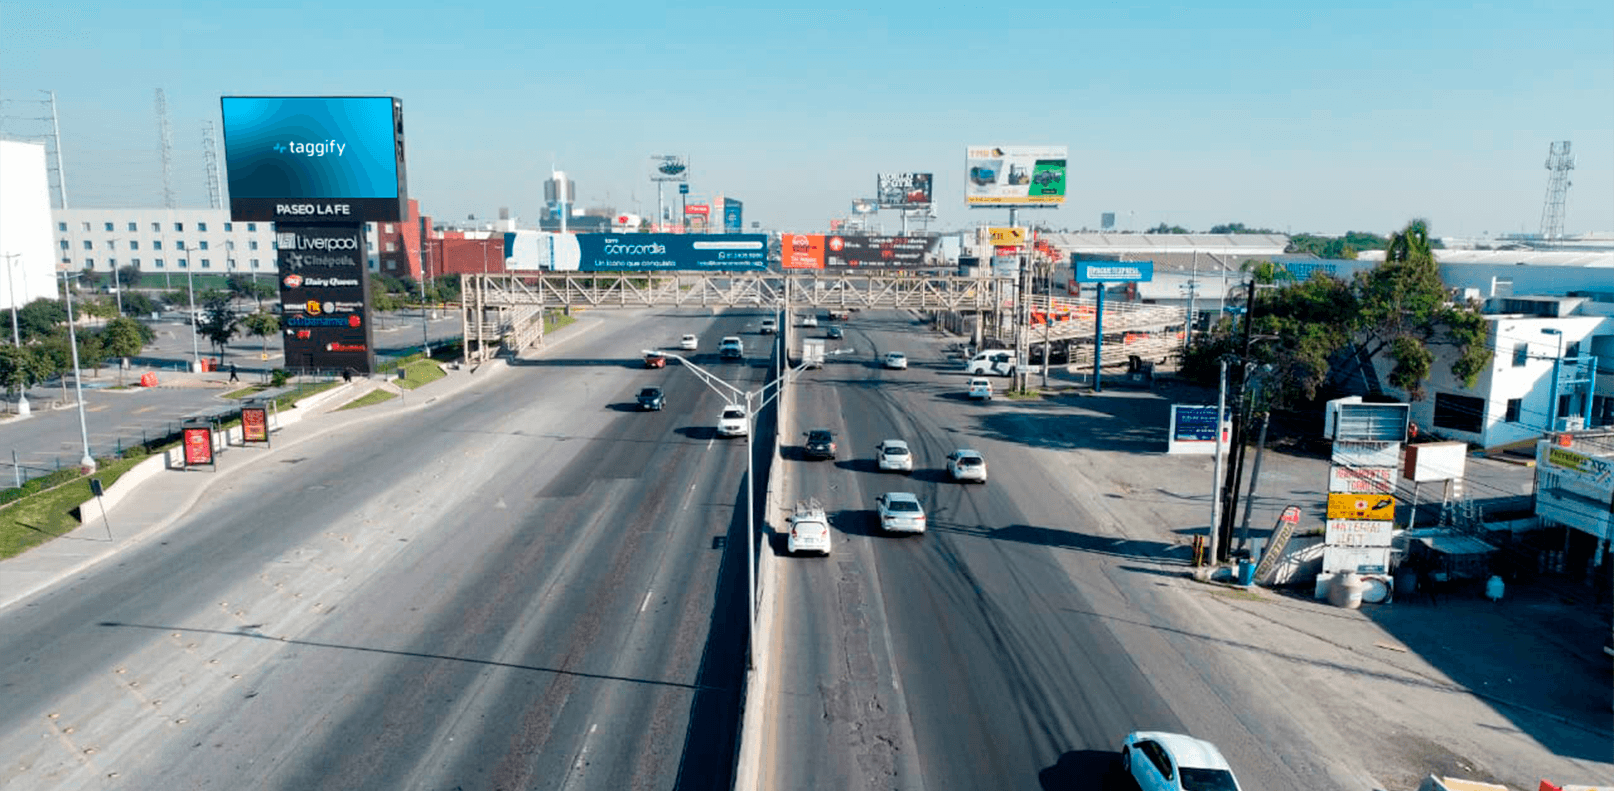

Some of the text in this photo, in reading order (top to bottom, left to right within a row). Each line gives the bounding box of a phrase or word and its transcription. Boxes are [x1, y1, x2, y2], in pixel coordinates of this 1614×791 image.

[289, 140, 346, 157] taggify
[880, 172, 914, 181] WORLD
[276, 204, 351, 215] PASEO LA FE
[297, 235, 358, 252] Liverpool
[604, 242, 666, 255] concordia
[305, 277, 359, 287] Dairy Queen
